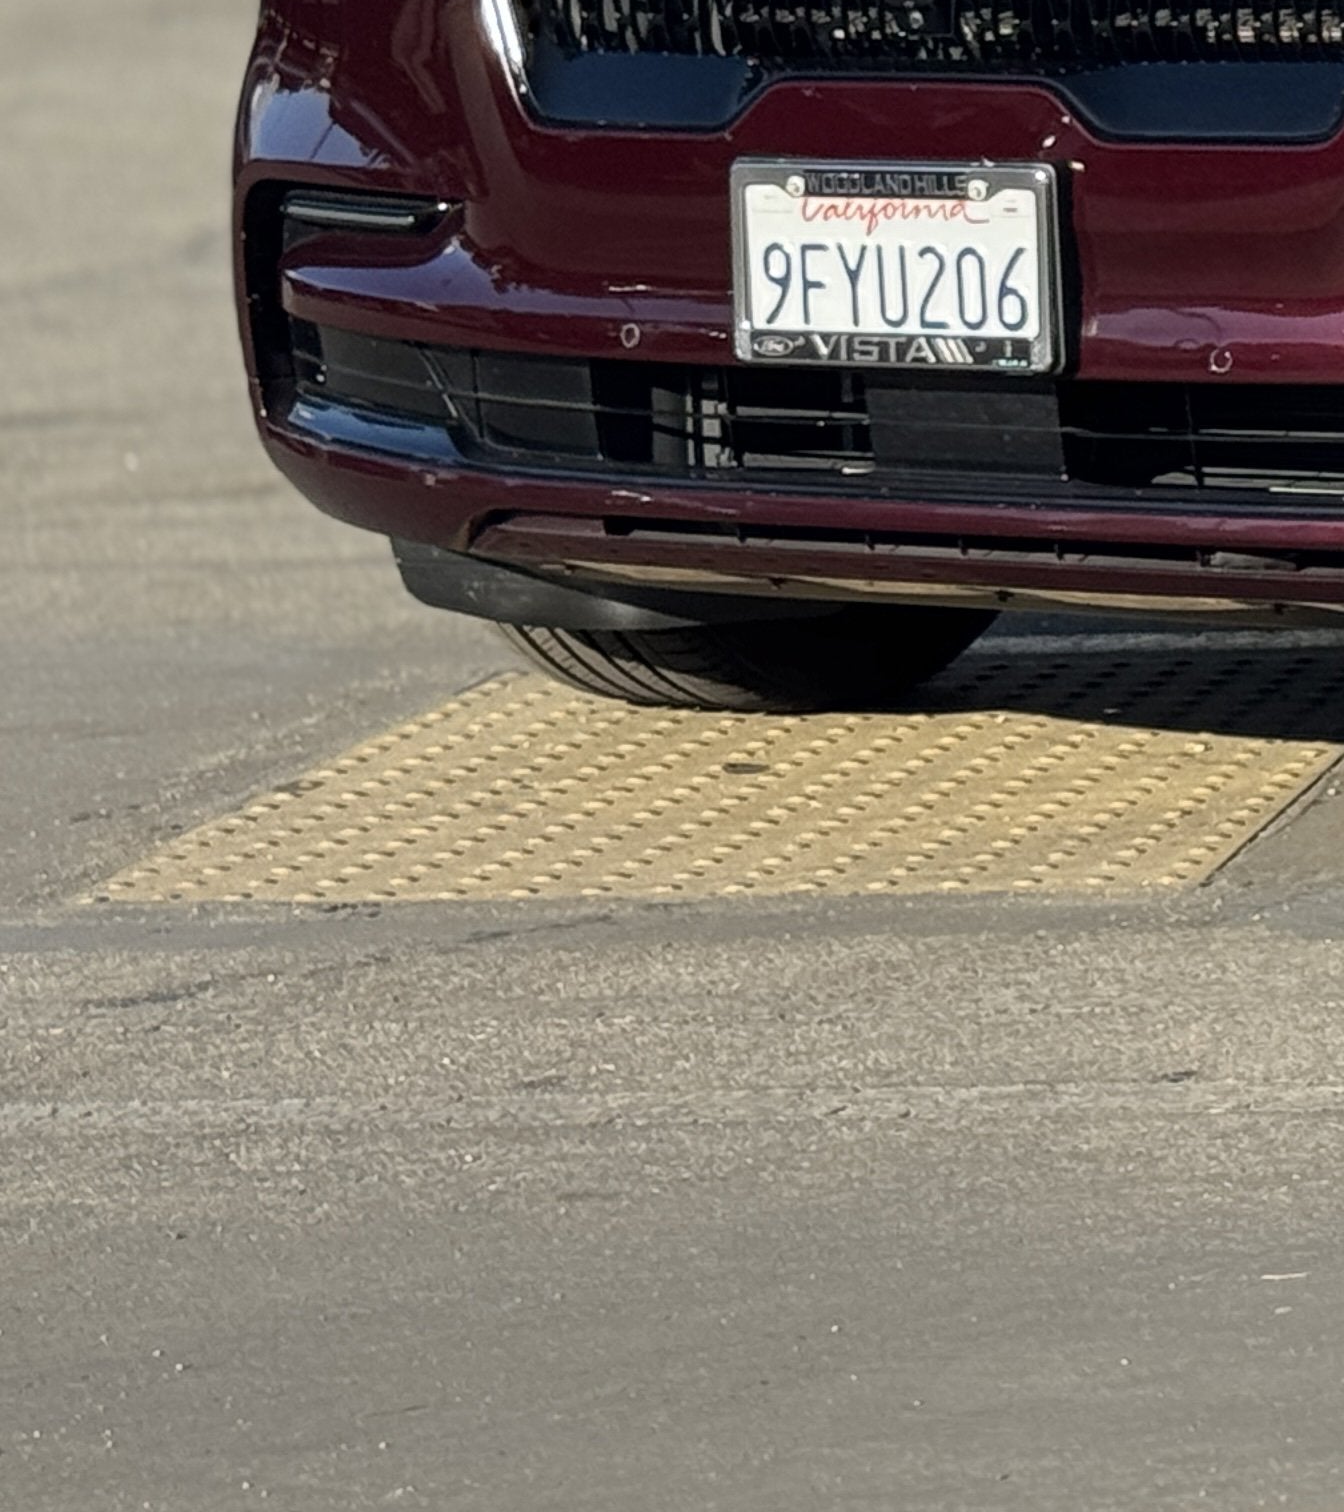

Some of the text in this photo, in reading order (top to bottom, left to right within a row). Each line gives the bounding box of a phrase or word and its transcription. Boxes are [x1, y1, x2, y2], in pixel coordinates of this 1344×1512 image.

[806, 172, 968, 197] WOODLAND HILLS
[763, 242, 1029, 331] 9FYU206
[809, 335, 937, 364] VISTA
